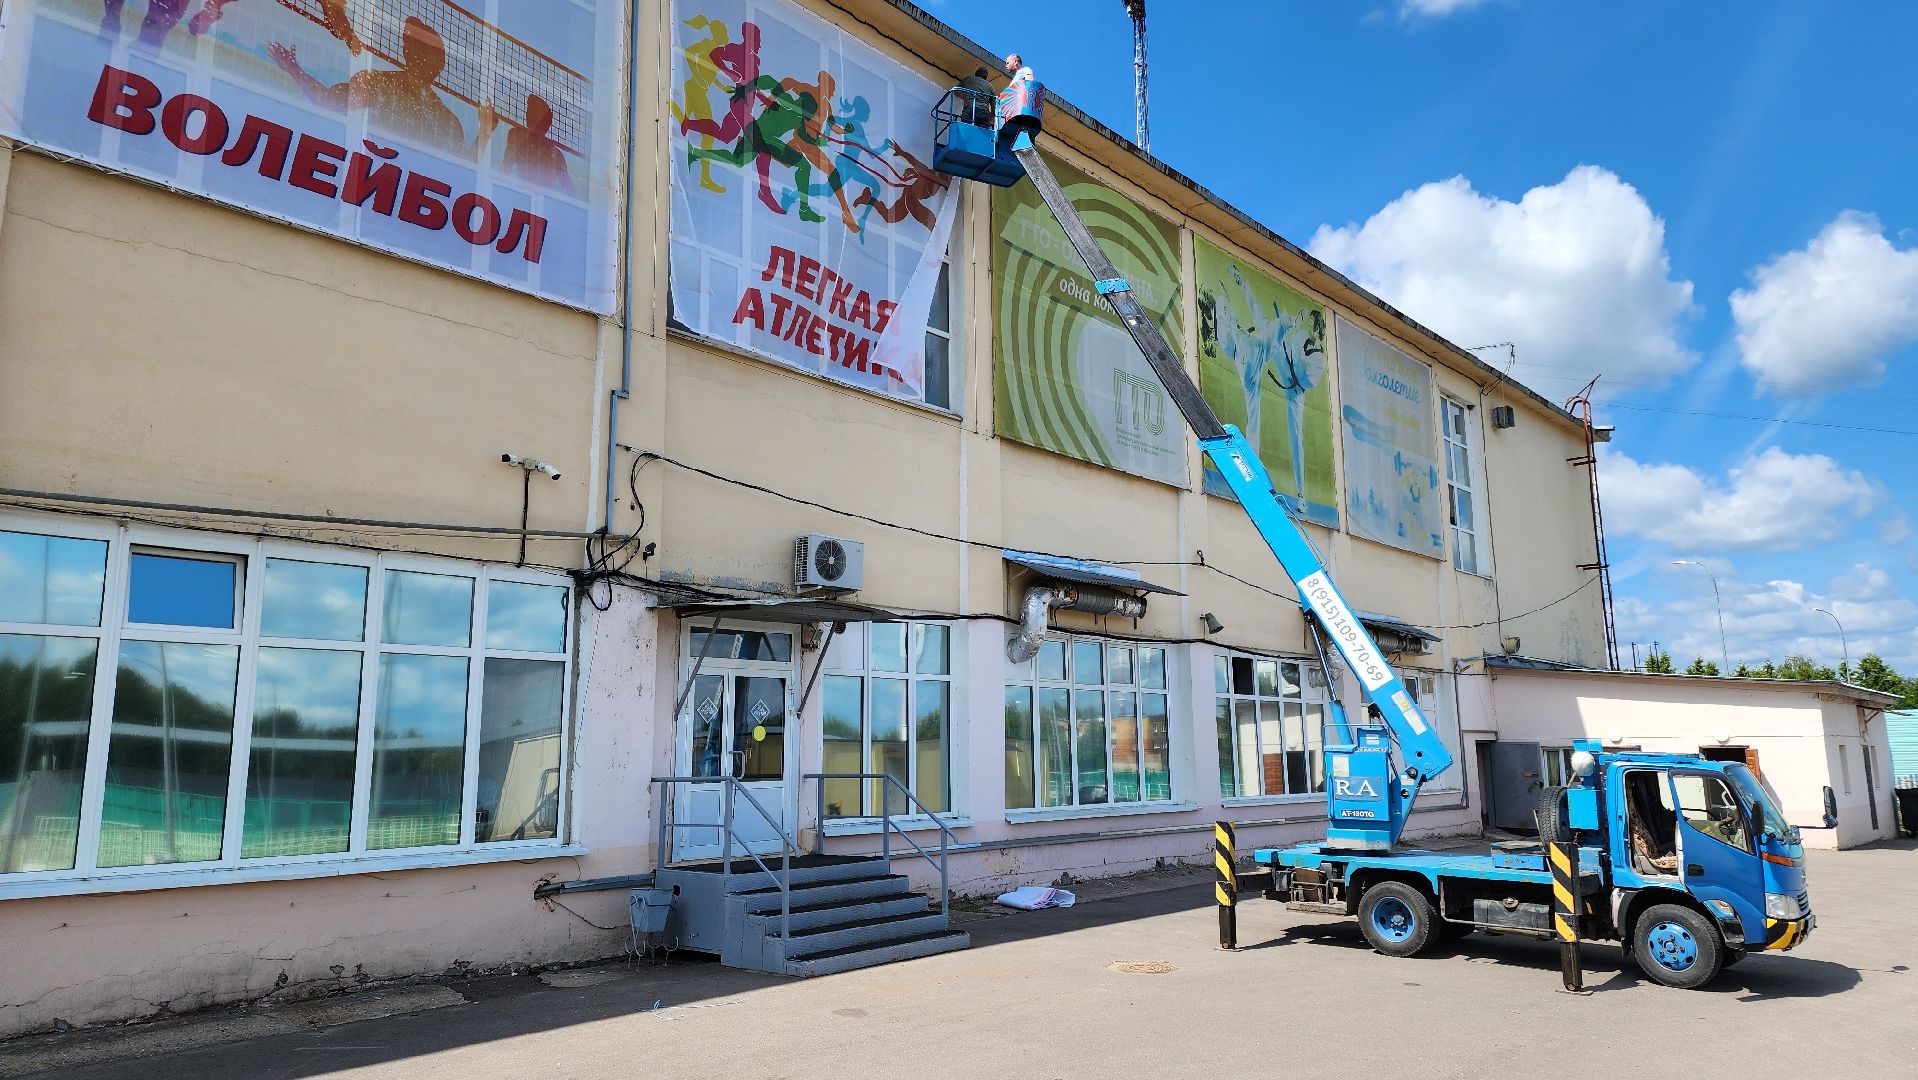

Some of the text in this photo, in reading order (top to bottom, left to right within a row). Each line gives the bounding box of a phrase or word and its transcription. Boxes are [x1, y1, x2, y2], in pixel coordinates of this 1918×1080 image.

[87, 64, 548, 264] ВОЛЕЙБОЛ
[731, 287, 905, 383] АТЛЕТИ
[761, 245, 899, 335] ЛЕГКАЯ
[1059, 277, 1090, 304] одна
